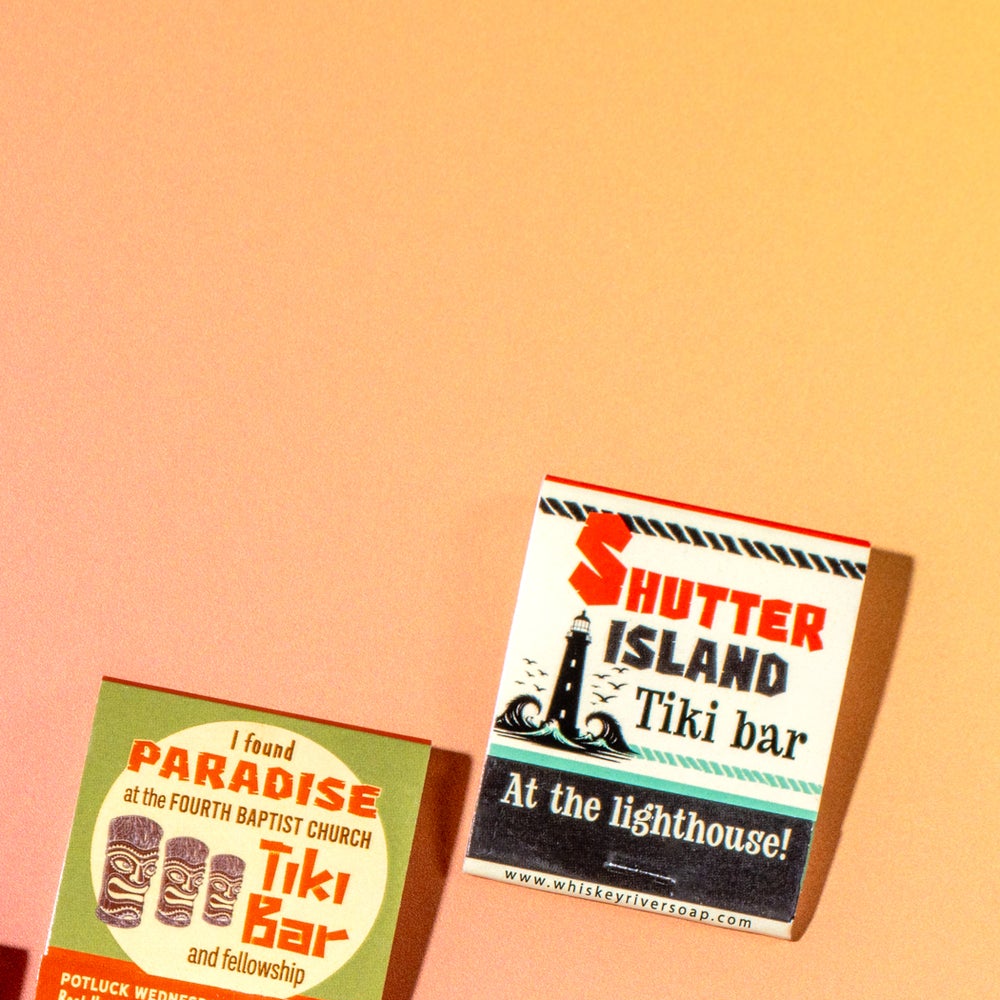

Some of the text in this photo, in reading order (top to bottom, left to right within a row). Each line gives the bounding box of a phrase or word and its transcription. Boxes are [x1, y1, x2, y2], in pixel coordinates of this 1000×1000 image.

[568, 512, 827, 652] SHUTTER
[603, 620, 789, 697] ISLAND
[230, 730, 296, 761] I found
[636, 686, 808, 760] Tiki bar
[127, 739, 382, 819] PARADISE
[124, 786, 372, 849] at the FOURTH BAPTIST CHURCH
[500, 772, 792, 861] At the lighthouse!
[259, 839, 350, 905] Tiki
[505, 869, 752, 928] www.whiskeyriversoap.com
[241, 893, 349, 958] Bar
[60, 972, 129, 997] POTLUCK
[187, 947, 305, 988] and fellowship
